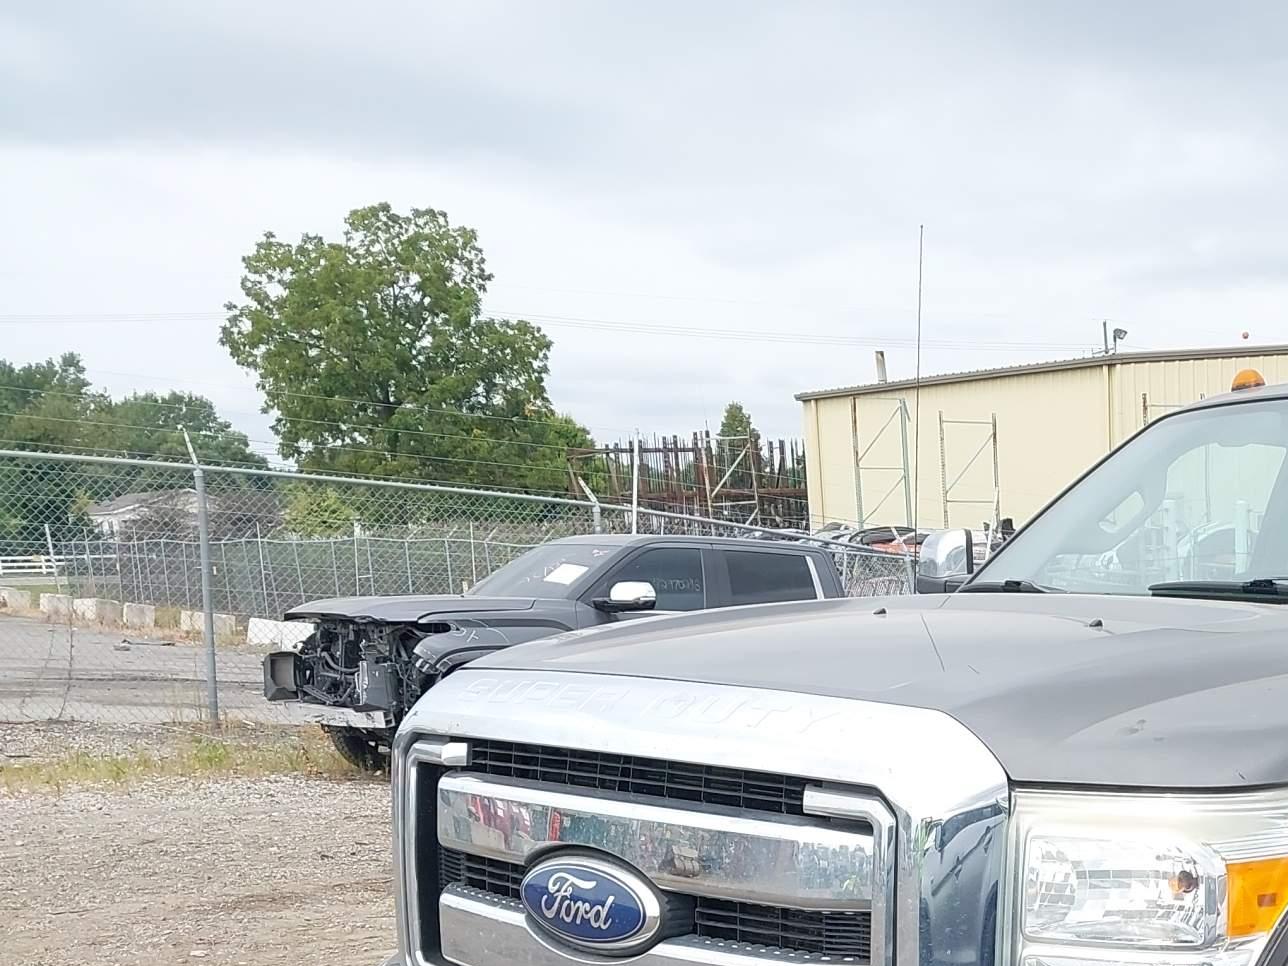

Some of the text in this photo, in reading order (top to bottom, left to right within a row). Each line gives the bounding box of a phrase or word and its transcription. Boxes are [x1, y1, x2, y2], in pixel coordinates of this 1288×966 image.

[457, 678, 840, 735] SUPER DUTY
[541, 872, 614, 930] Ford
